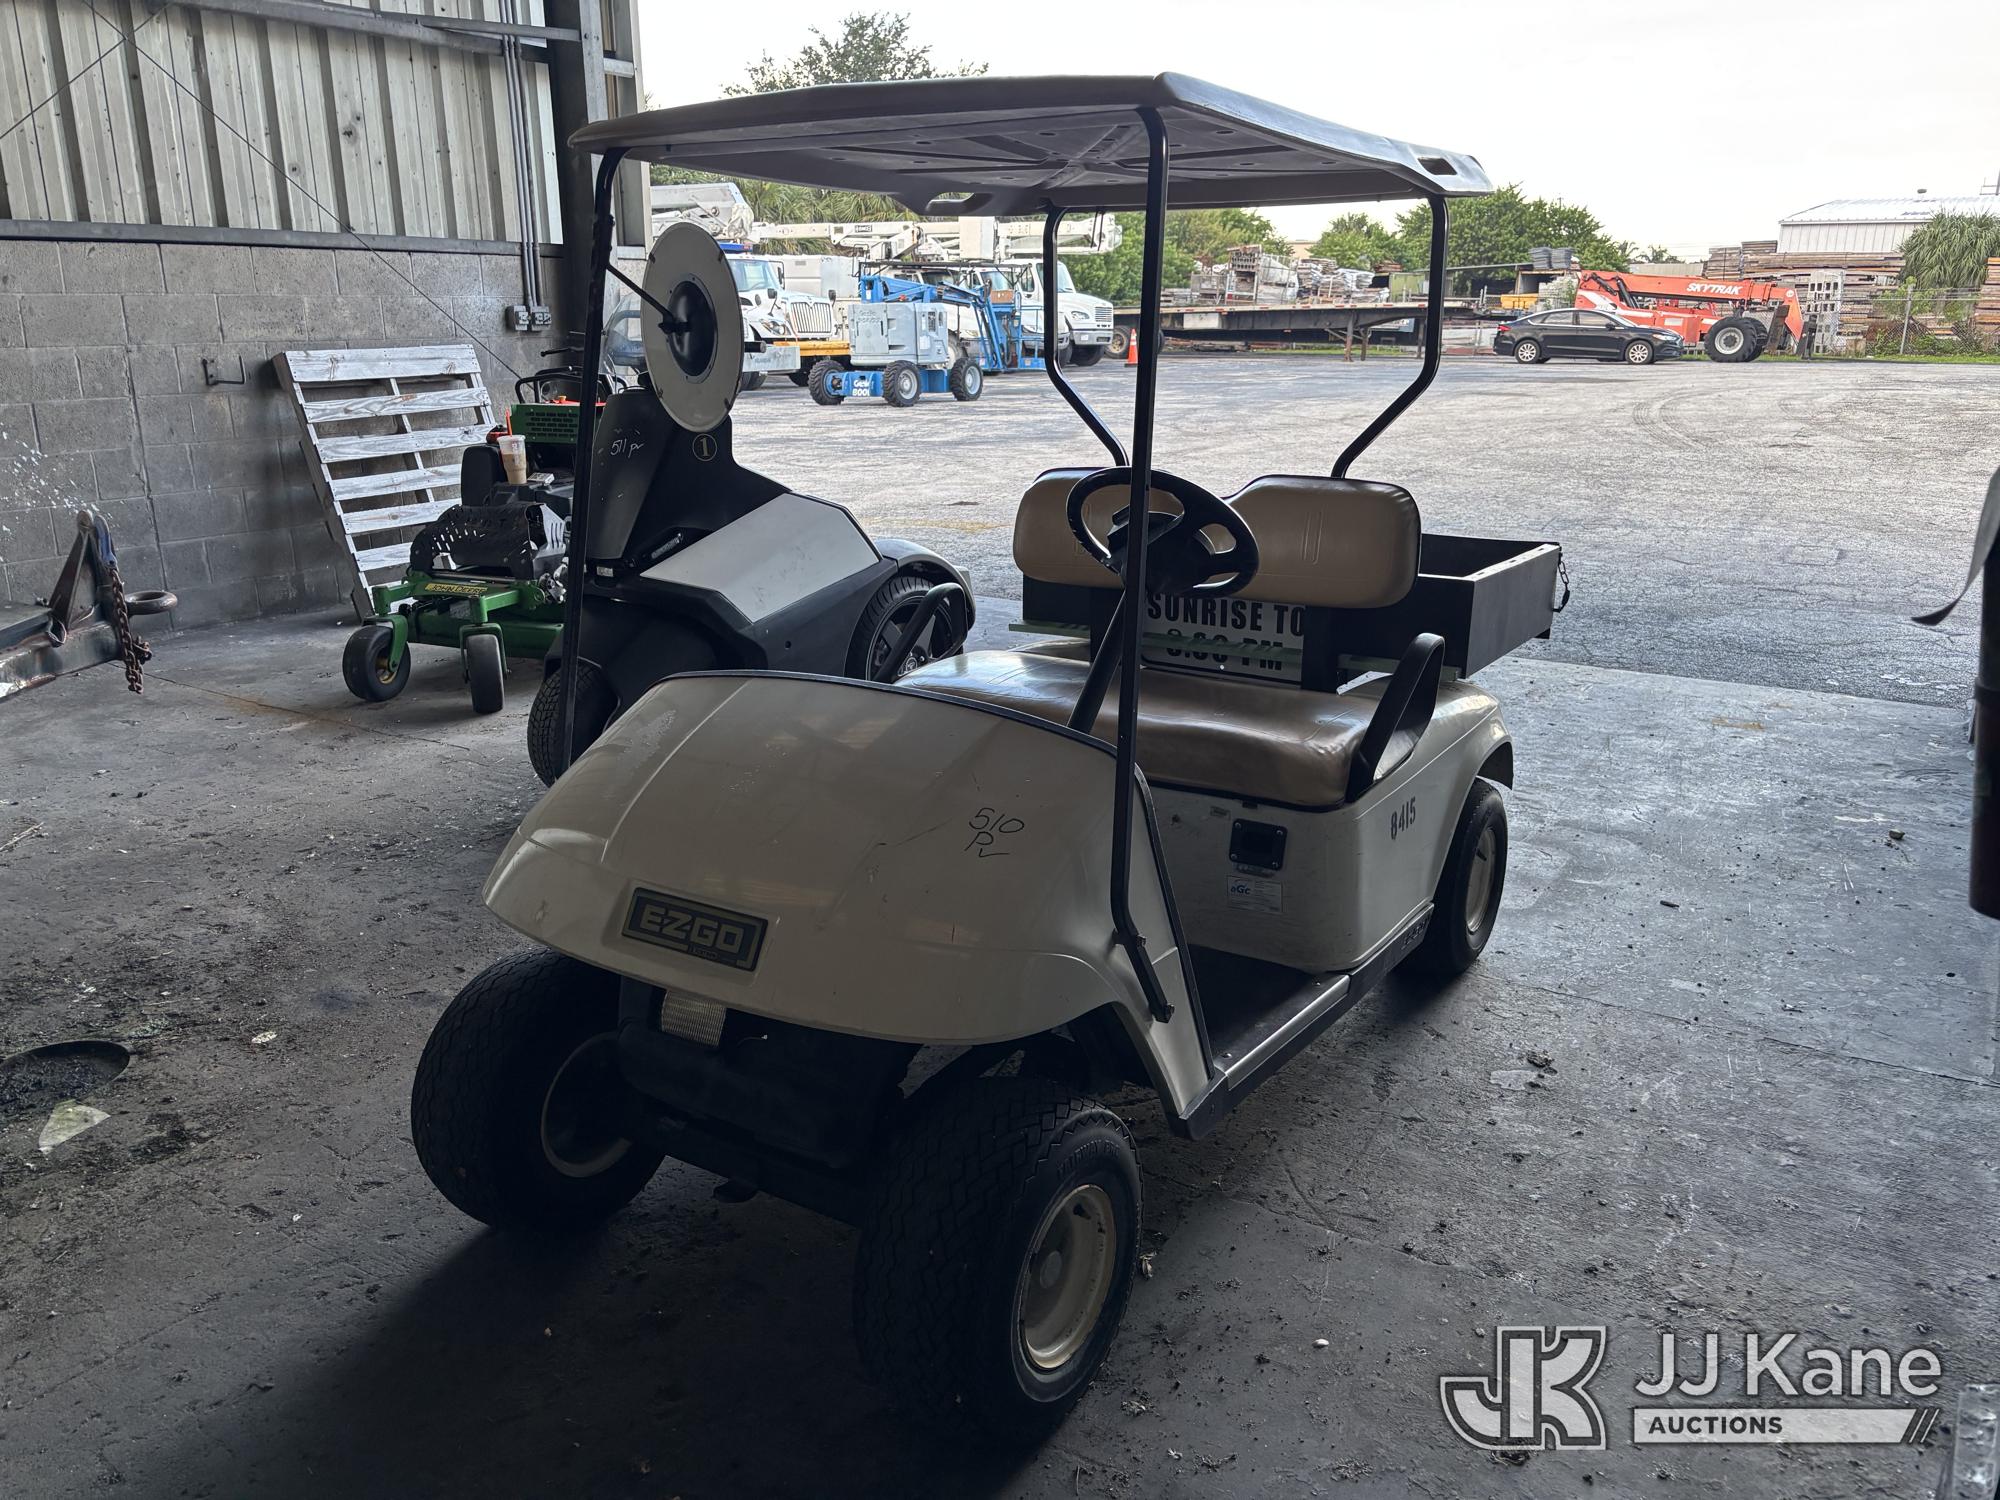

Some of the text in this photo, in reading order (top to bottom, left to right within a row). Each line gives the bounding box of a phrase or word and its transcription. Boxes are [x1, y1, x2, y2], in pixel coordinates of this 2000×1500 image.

[1686, 282, 1743, 295] SKYTRAK
[431, 583, 456, 592] JOHN
[1147, 593, 1262, 631] SUNRISE
[968, 807, 1025, 833] 510
[1391, 796, 1416, 840] 8415
[640, 903, 745, 954] EZGO
